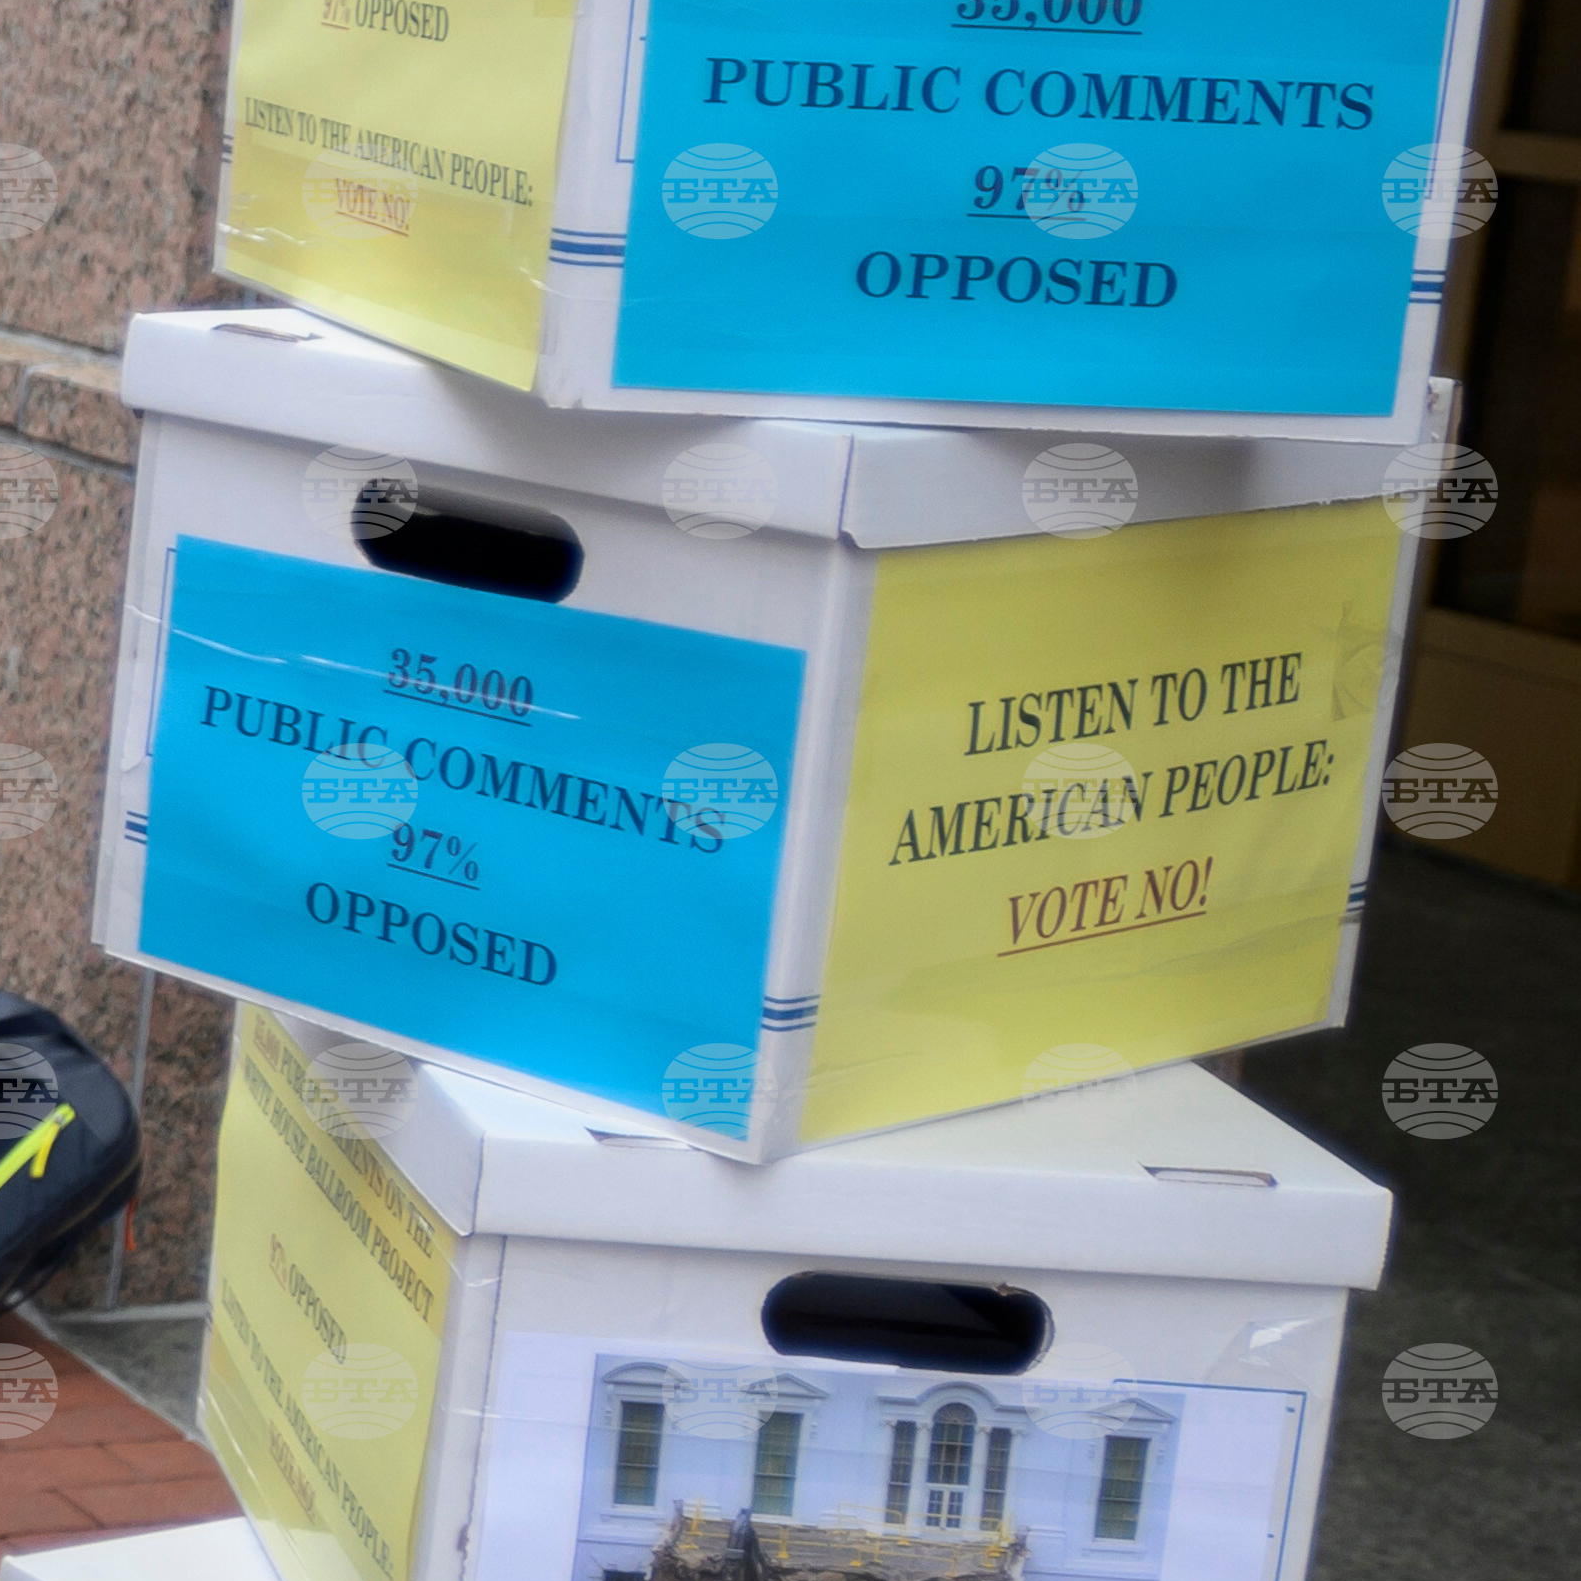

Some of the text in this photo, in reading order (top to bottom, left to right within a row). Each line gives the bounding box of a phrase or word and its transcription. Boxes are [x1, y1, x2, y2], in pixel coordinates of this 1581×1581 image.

[702, 57, 1377, 132] PUBLIC COMMENTS
[245, 97, 534, 207] LISTEN TO THE AMERICAN PEOPLE:
[335, 177, 378, 220] VOTE
[971, 163, 1088, 215] 97%
[854, 250, 1181, 311] OPPOSED
[388, 648, 533, 717] 35,000
[964, 652, 1303, 756] LISTEN TO THE
[200, 685, 726, 854] PUBLIC COMMENTS
[888, 738, 1335, 866] AMERICAN PEOPLE:
[390, 822, 480, 883] 97%
[305, 882, 559, 986] OPPOSED
[1007, 856, 1214, 947] VOTE NO!
[289, 1264, 347, 1365] OPPOSED
[371, 1223, 435, 1323] PROJECT
